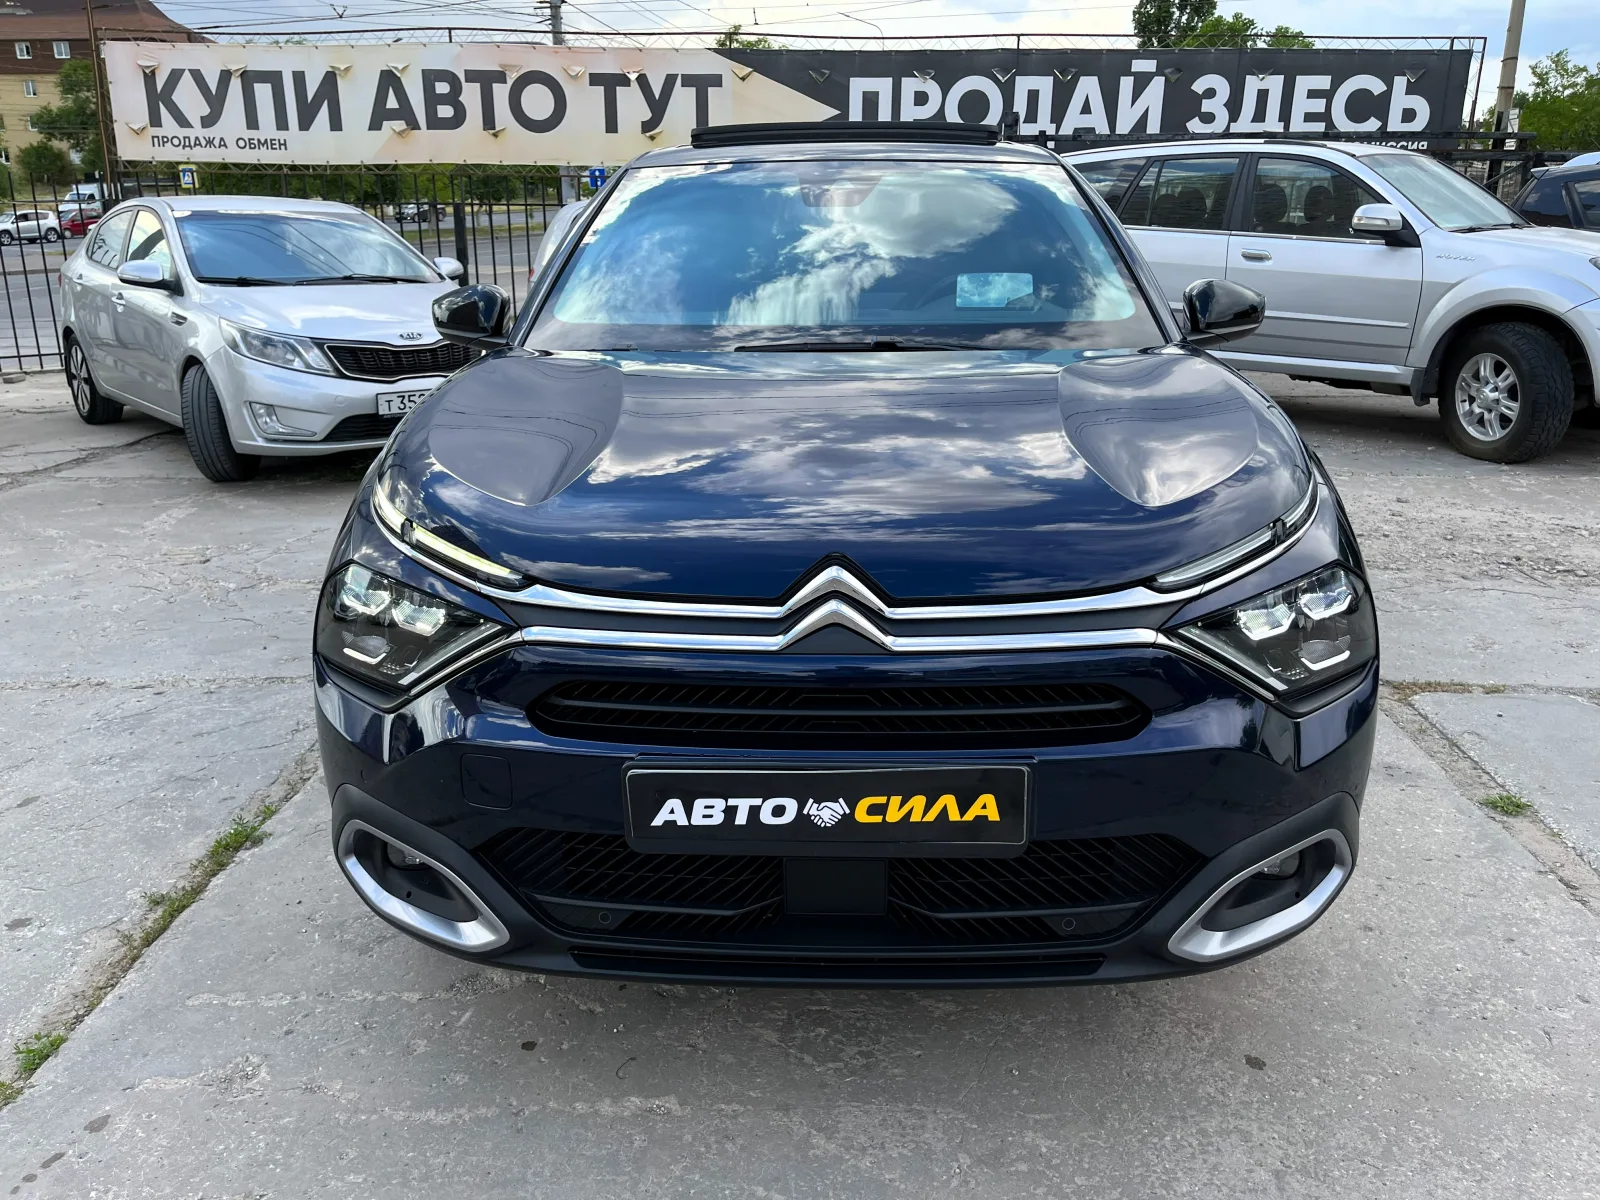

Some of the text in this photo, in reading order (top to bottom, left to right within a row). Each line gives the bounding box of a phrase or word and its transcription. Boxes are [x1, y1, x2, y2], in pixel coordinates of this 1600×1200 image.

[142, 68, 723, 134] КУПИ АВТО ТУТ
[848, 59, 1431, 148] ПРОДАЙ ЗДЕСЬ
[151, 135, 288, 151] ПРОДАЖА ОБМЕН
[650, 793, 1002, 827] АВТО СИЛА
